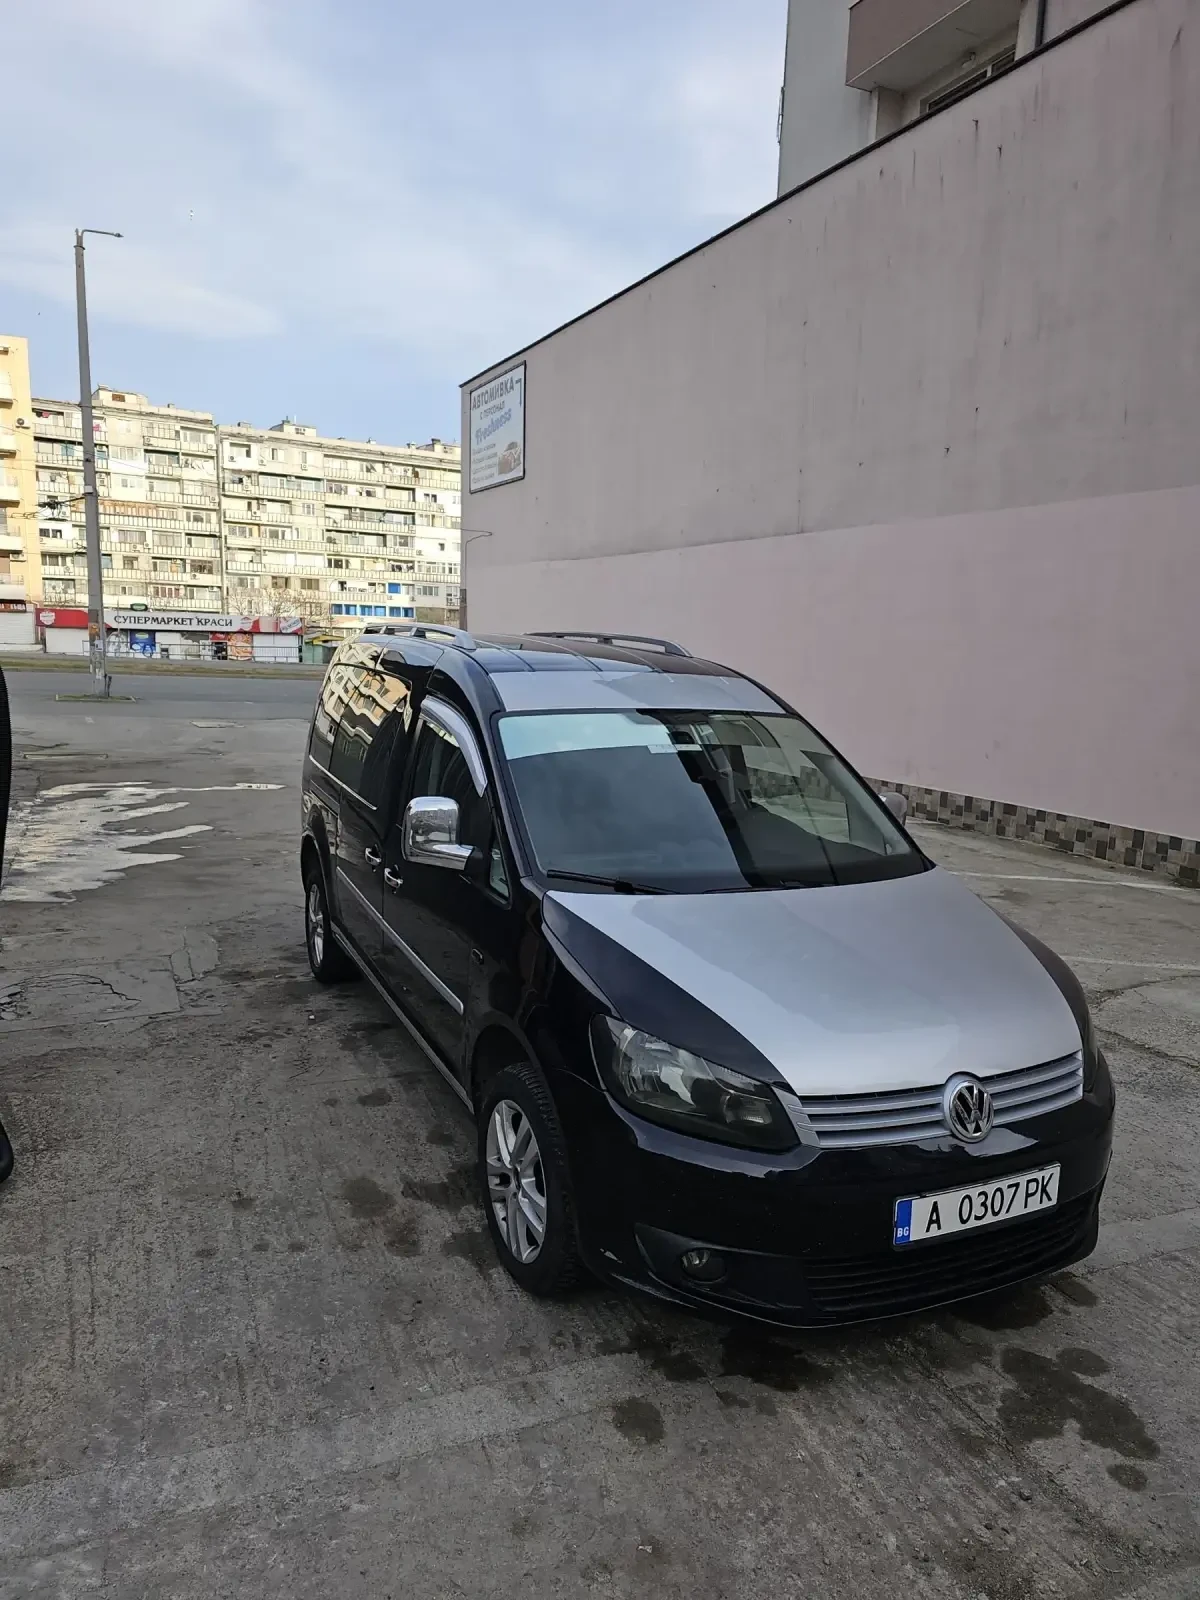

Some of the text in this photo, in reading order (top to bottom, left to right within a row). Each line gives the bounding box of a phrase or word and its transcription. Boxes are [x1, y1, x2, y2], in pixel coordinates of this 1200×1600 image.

[472, 376, 515, 411] АВТОМИВКА
[113, 615, 233, 627] СУПЕРМАРКЕТ КРАСИ
[925, 1200, 942, 1233] A
[897, 1226, 909, 1238] BG
